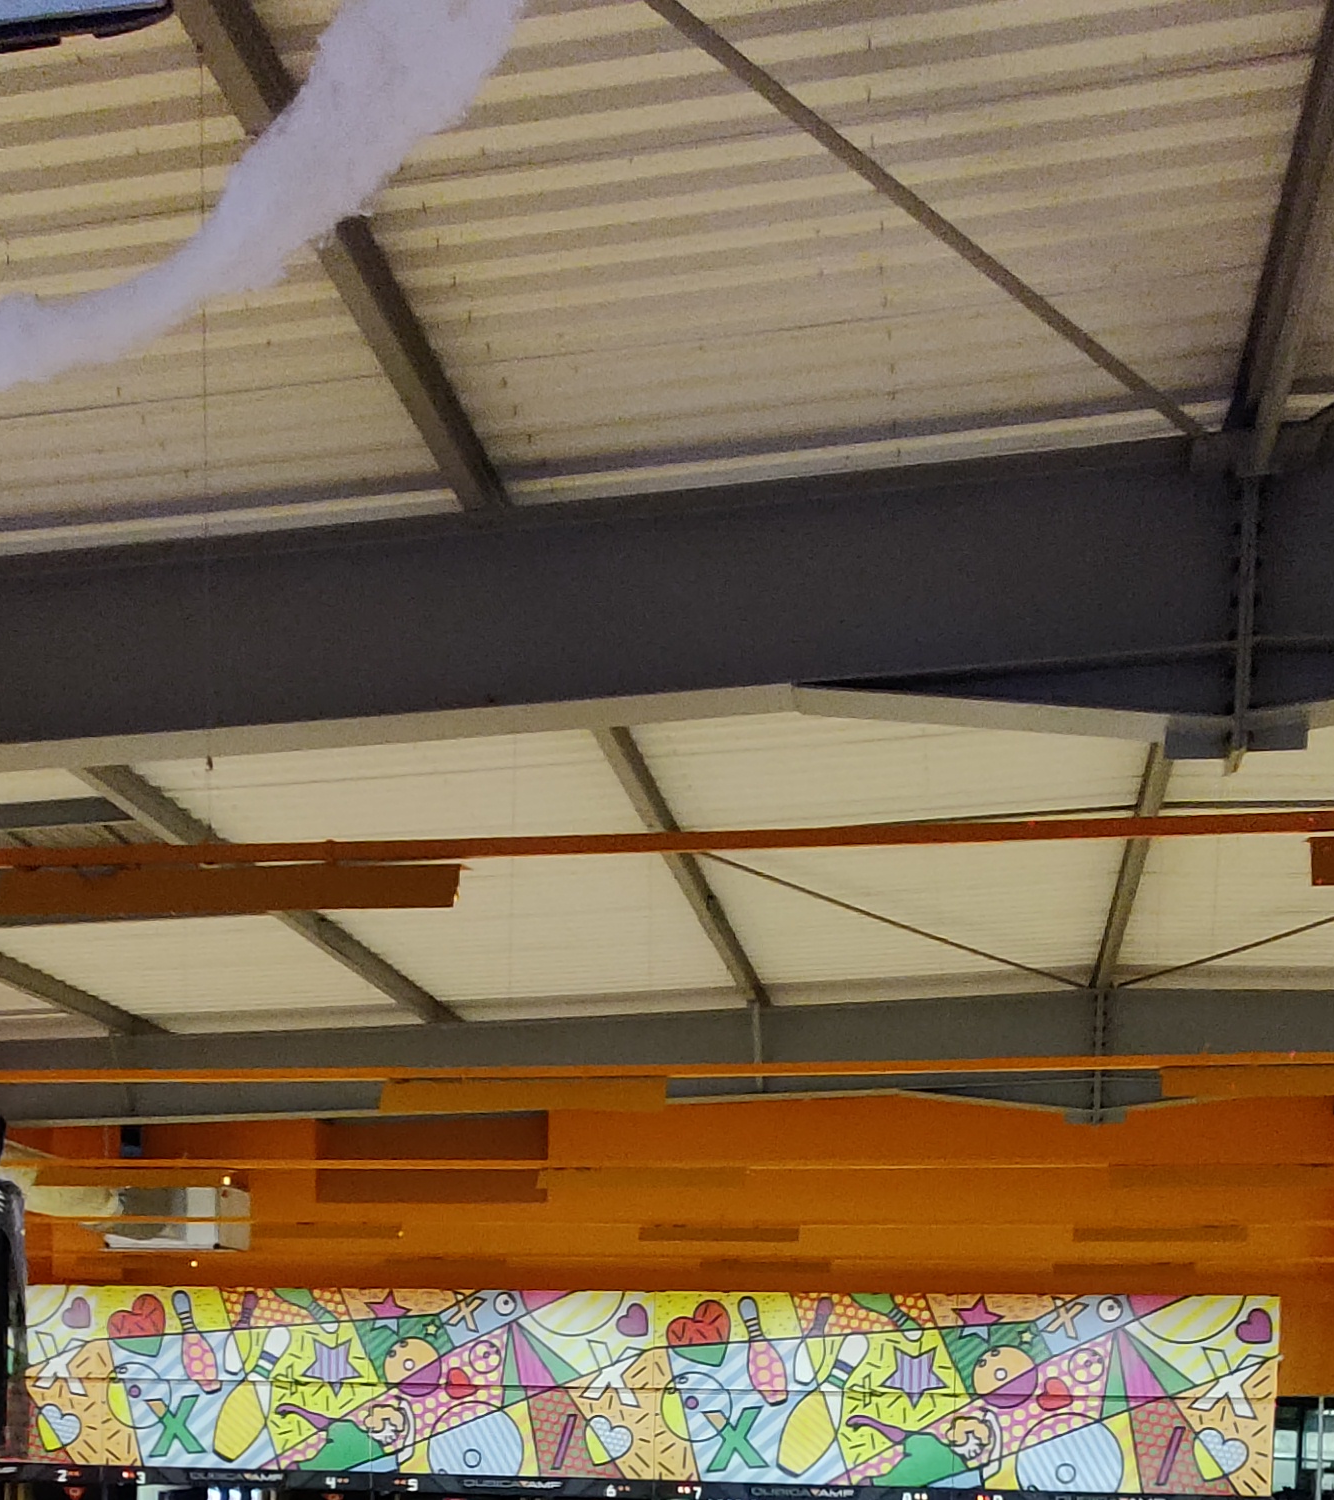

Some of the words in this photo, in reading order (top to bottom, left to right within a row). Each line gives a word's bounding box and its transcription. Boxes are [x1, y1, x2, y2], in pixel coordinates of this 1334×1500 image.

[56, 1470, 68, 1482] 2
[135, 1471, 147, 1483] 3
[325, 1475, 337, 1488] 4
[606, 1483, 618, 1497] 6
[691, 1487, 703, 1500] 7
